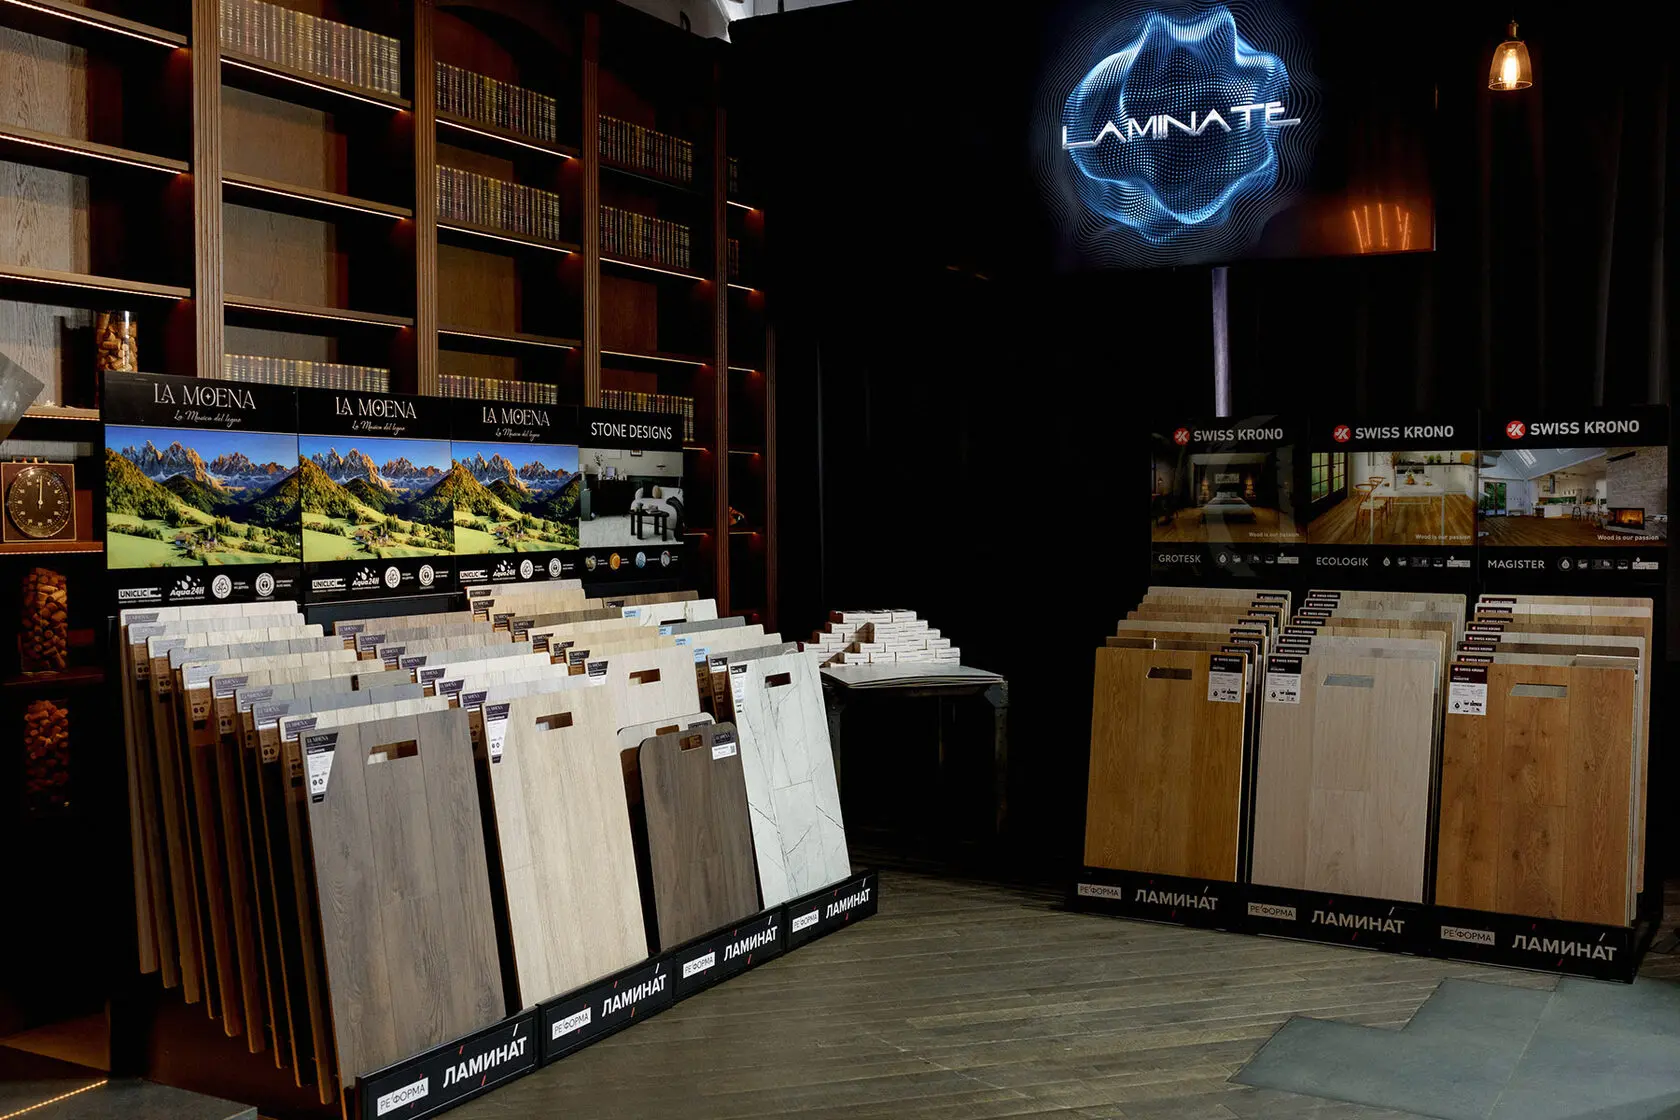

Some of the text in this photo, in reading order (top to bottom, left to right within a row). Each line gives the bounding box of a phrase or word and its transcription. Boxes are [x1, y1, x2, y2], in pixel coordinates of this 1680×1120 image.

[1062, 101, 1301, 149] LAMINATE
[154, 383, 257, 410] LA MOENA
[336, 396, 417, 419] LA MOENA
[482, 406, 550, 427] LA MOENA
[1530, 420, 1639, 435] SWISS KRONO
[591, 422, 673, 440] STONE DESIGNS
[1194, 428, 1283, 442] SWISS KRONO
[1355, 425, 1454, 439] SWISS KRONO
[1158, 554, 1201, 563] GROTESK
[1316, 557, 1369, 566] ECOLOGIK
[1487, 559, 1545, 569] MAGISTER
[119, 589, 147, 598] UNICLIC
[312, 580, 335, 588] UNICLIC
[826, 884, 871, 919] ЛАМИНАТ
[1135, 887, 1218, 910] ЛАМИНАТ
[1311, 908, 1405, 934] ЛАМИНАТ
[724, 921, 778, 961] ЛАМИНАТ
[1512, 933, 1617, 961] ЛАМИНАТ
[602, 968, 666, 1017] ЛАМИНАТ
[443, 1030, 527, 1088] ЛАМИНАТ
